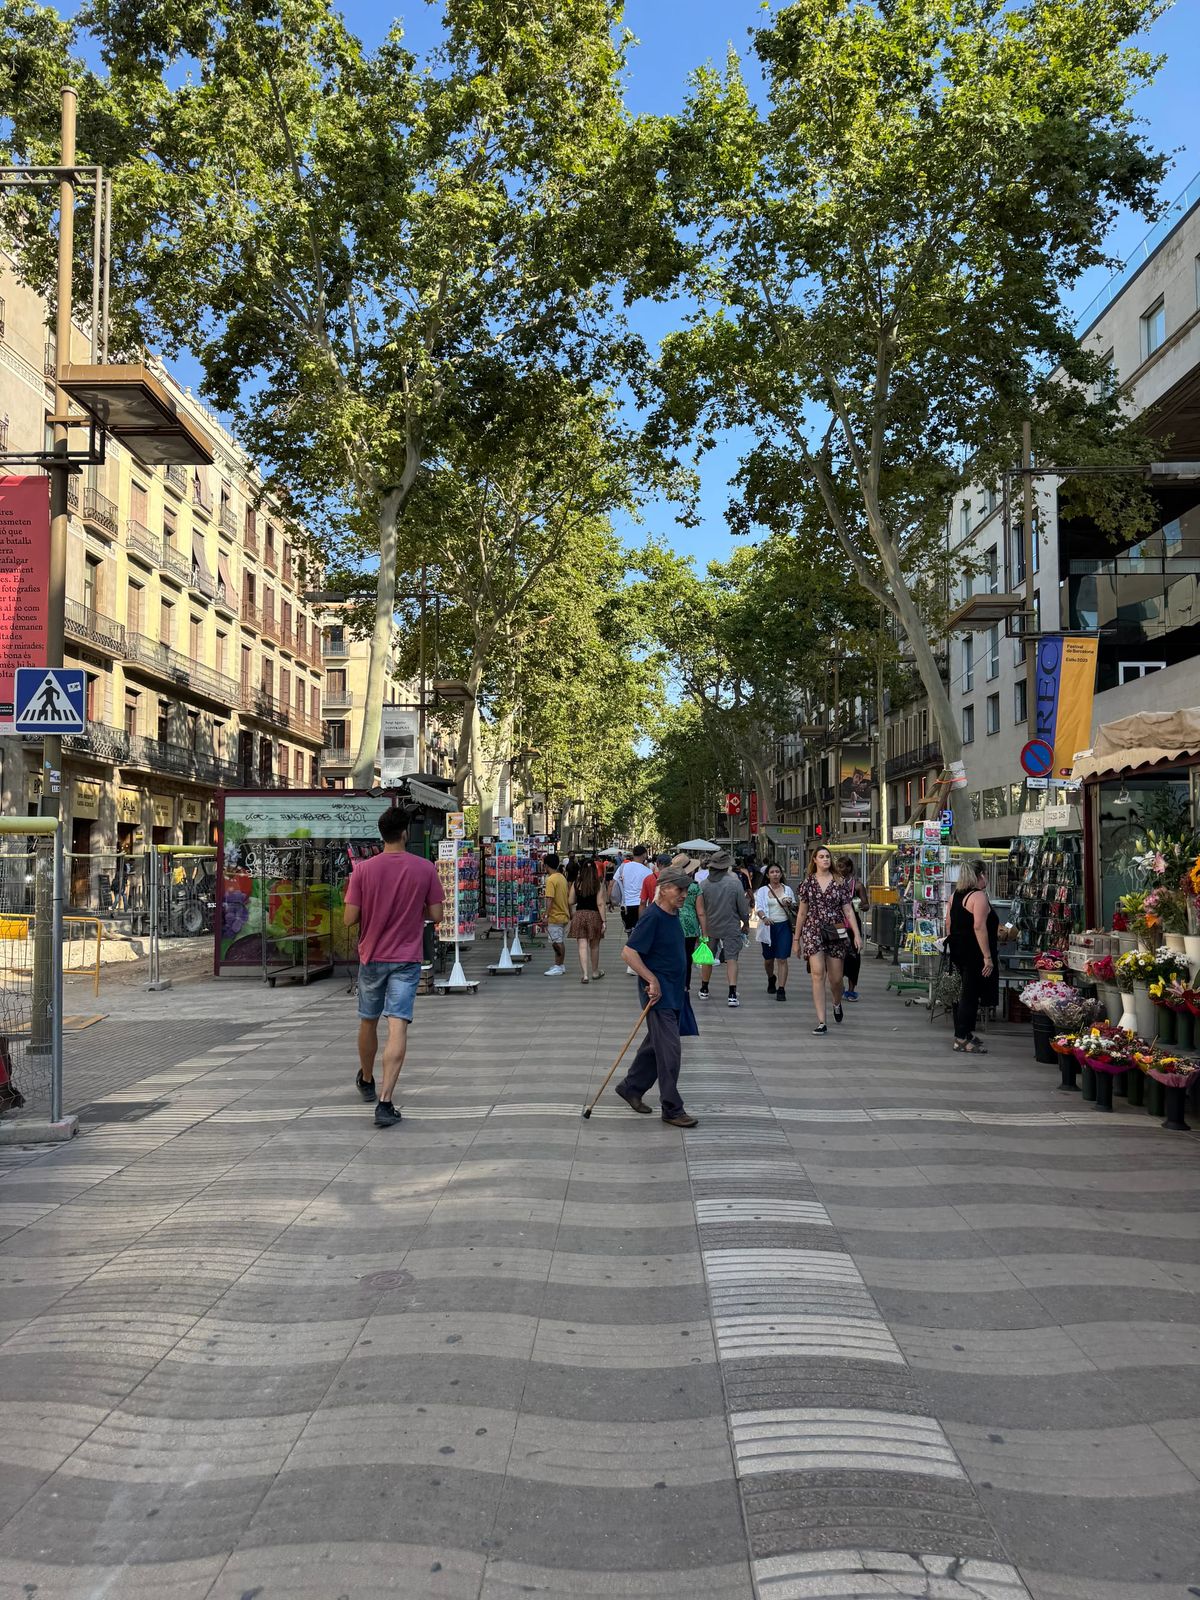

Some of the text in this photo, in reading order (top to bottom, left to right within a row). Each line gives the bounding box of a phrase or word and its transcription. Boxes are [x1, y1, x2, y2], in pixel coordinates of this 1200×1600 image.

[8, 529, 23, 537] que
[2, 584, 41, 594] fotografies
[2, 613, 38, 621] Les bones
